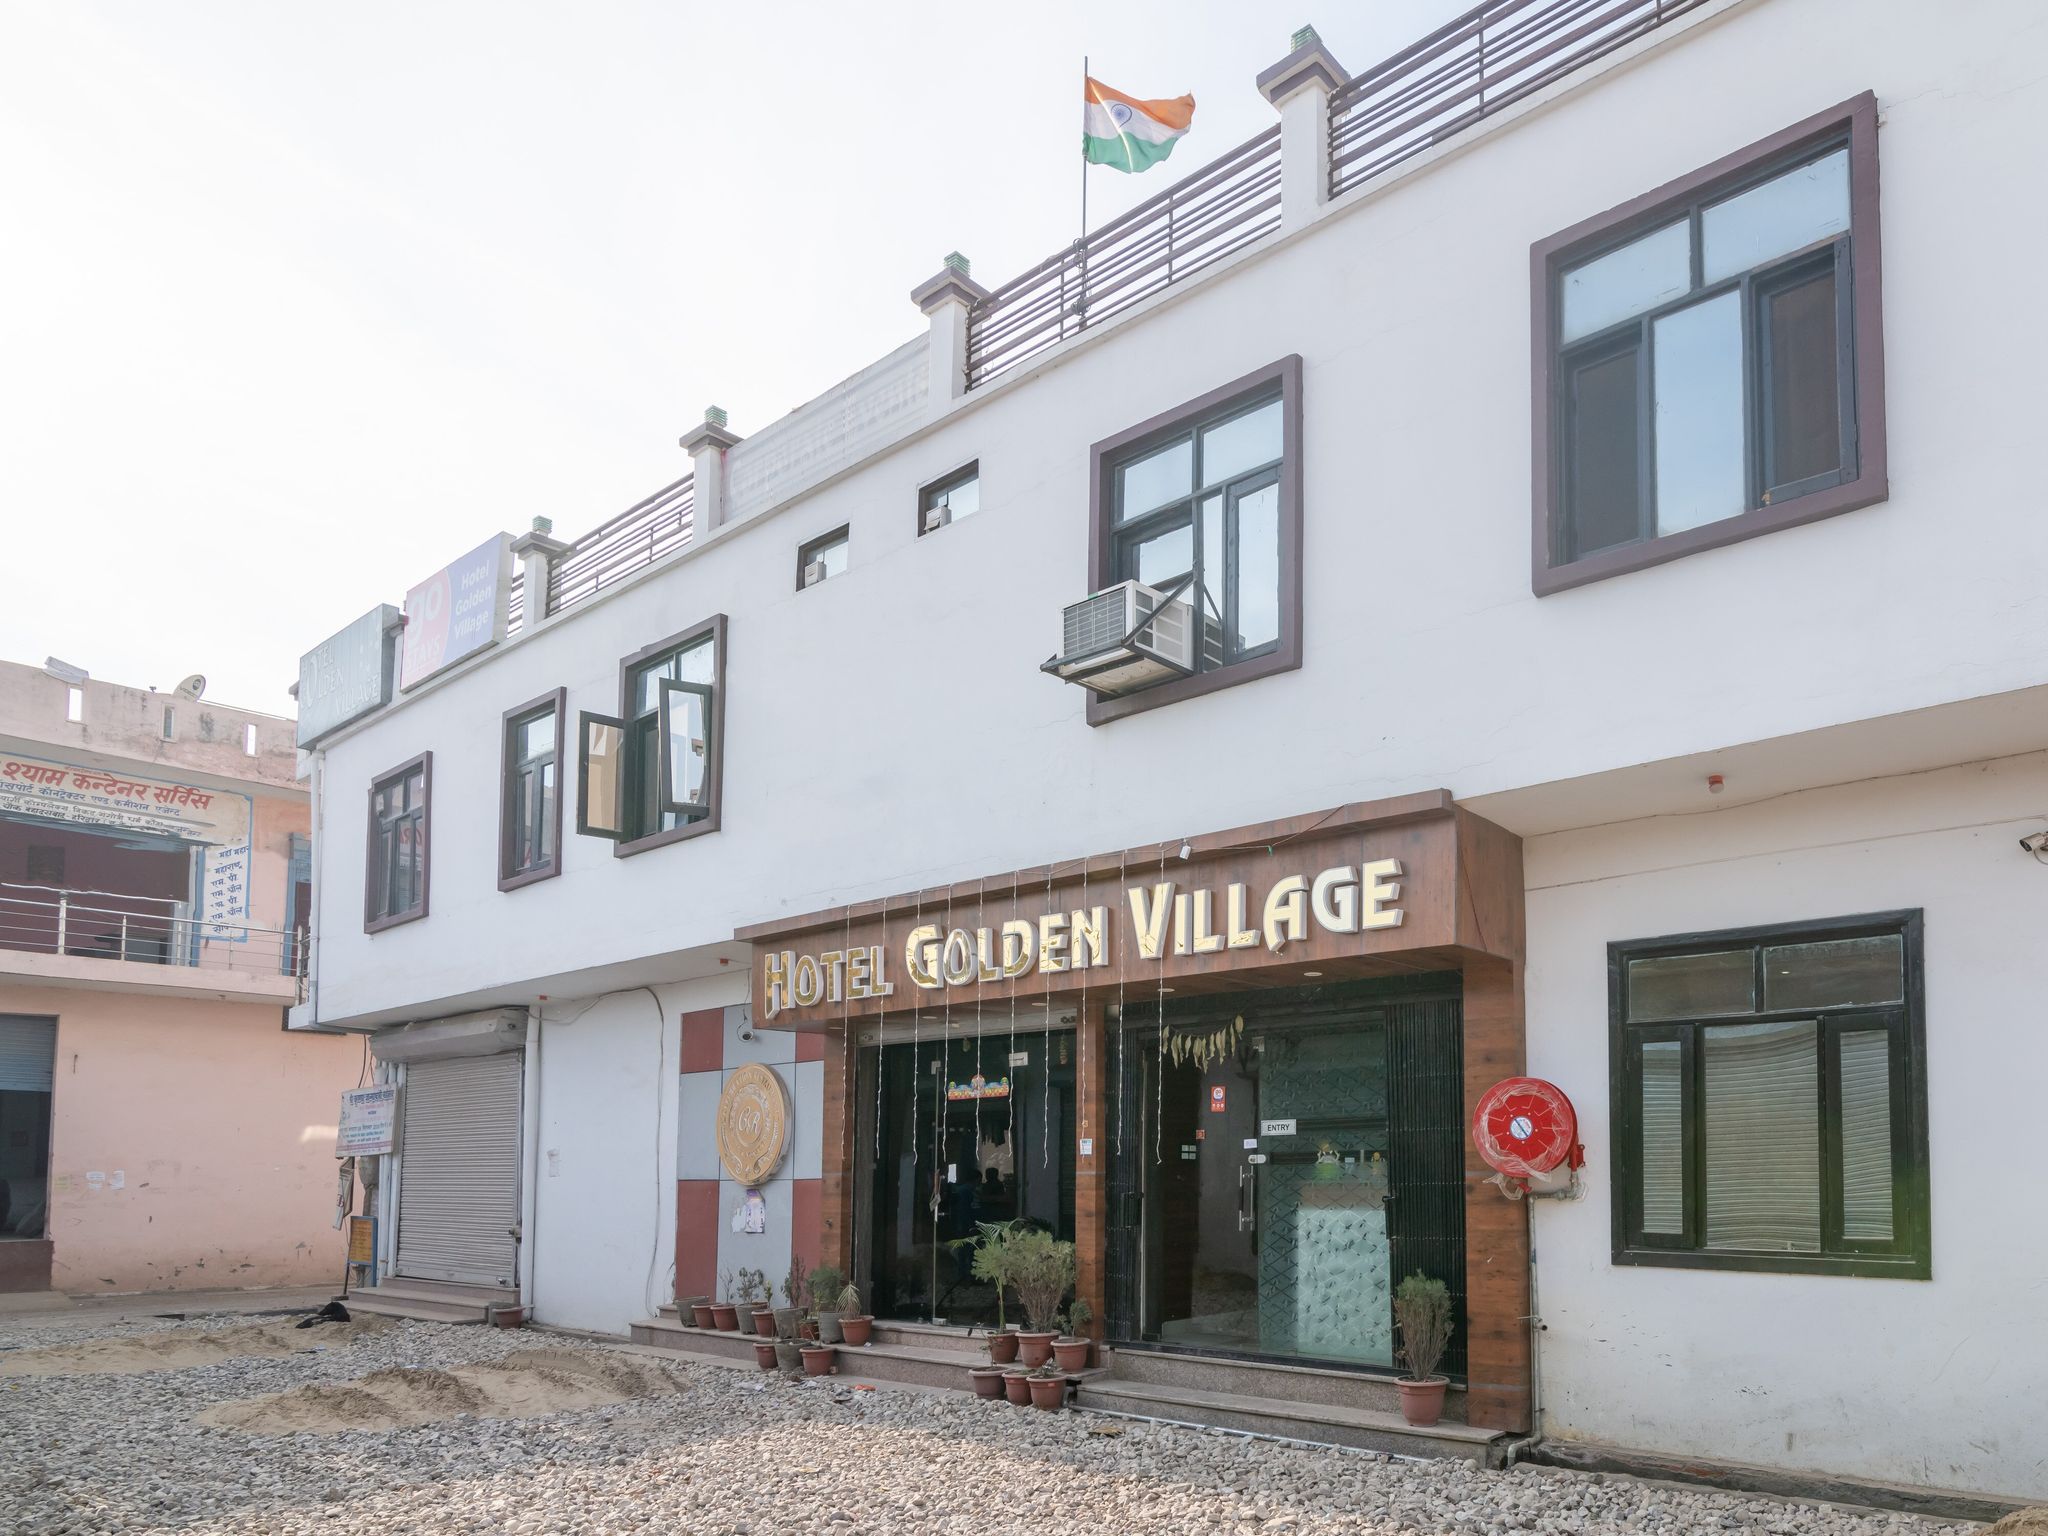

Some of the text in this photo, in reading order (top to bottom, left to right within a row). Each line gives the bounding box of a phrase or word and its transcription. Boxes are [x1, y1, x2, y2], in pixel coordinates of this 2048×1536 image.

[460, 559, 490, 591] Hotel
[455, 585, 492, 616] Golden
[454, 611, 489, 640] Village
[3, 761, 69, 787] श्याम
[764, 857, 1405, 1020] HOTEL GOLDEN VILLAGE
[1267, 1123, 1291, 1132] ENTRY
